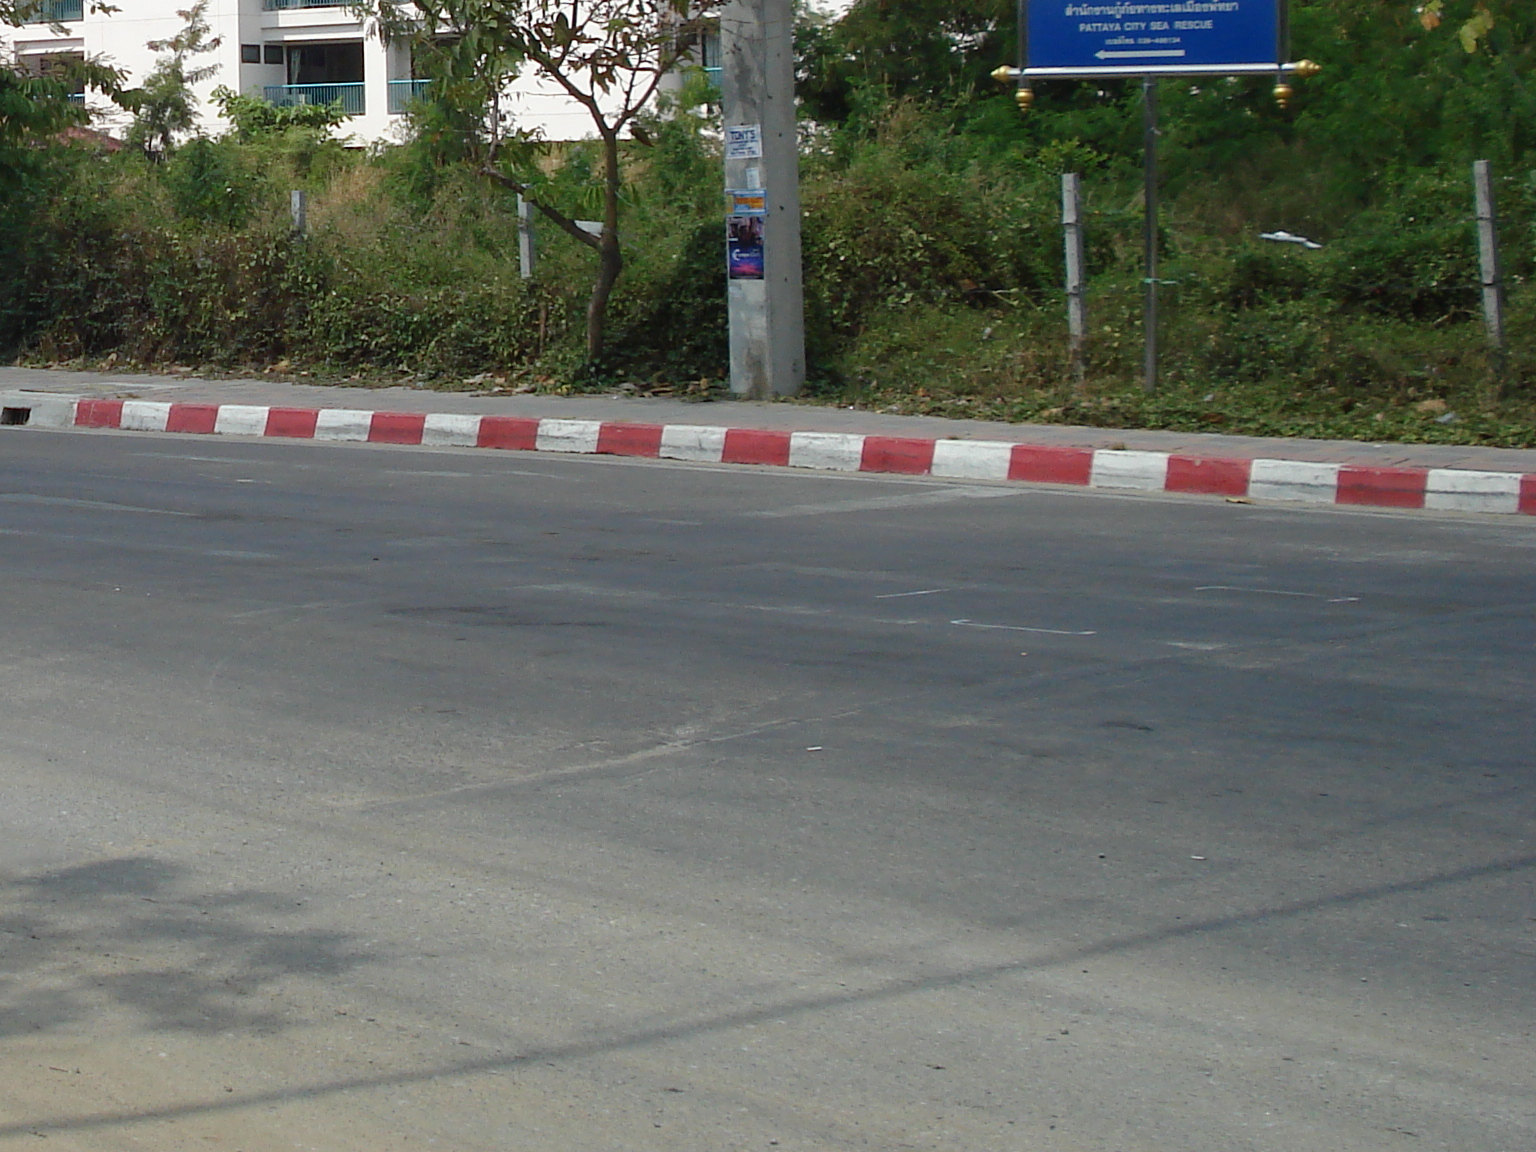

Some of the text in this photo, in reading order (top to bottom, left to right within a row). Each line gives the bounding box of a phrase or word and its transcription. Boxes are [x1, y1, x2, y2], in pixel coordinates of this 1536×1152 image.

[1079, 20, 1213, 33] PATTAYA CITY SEA RESCUE
